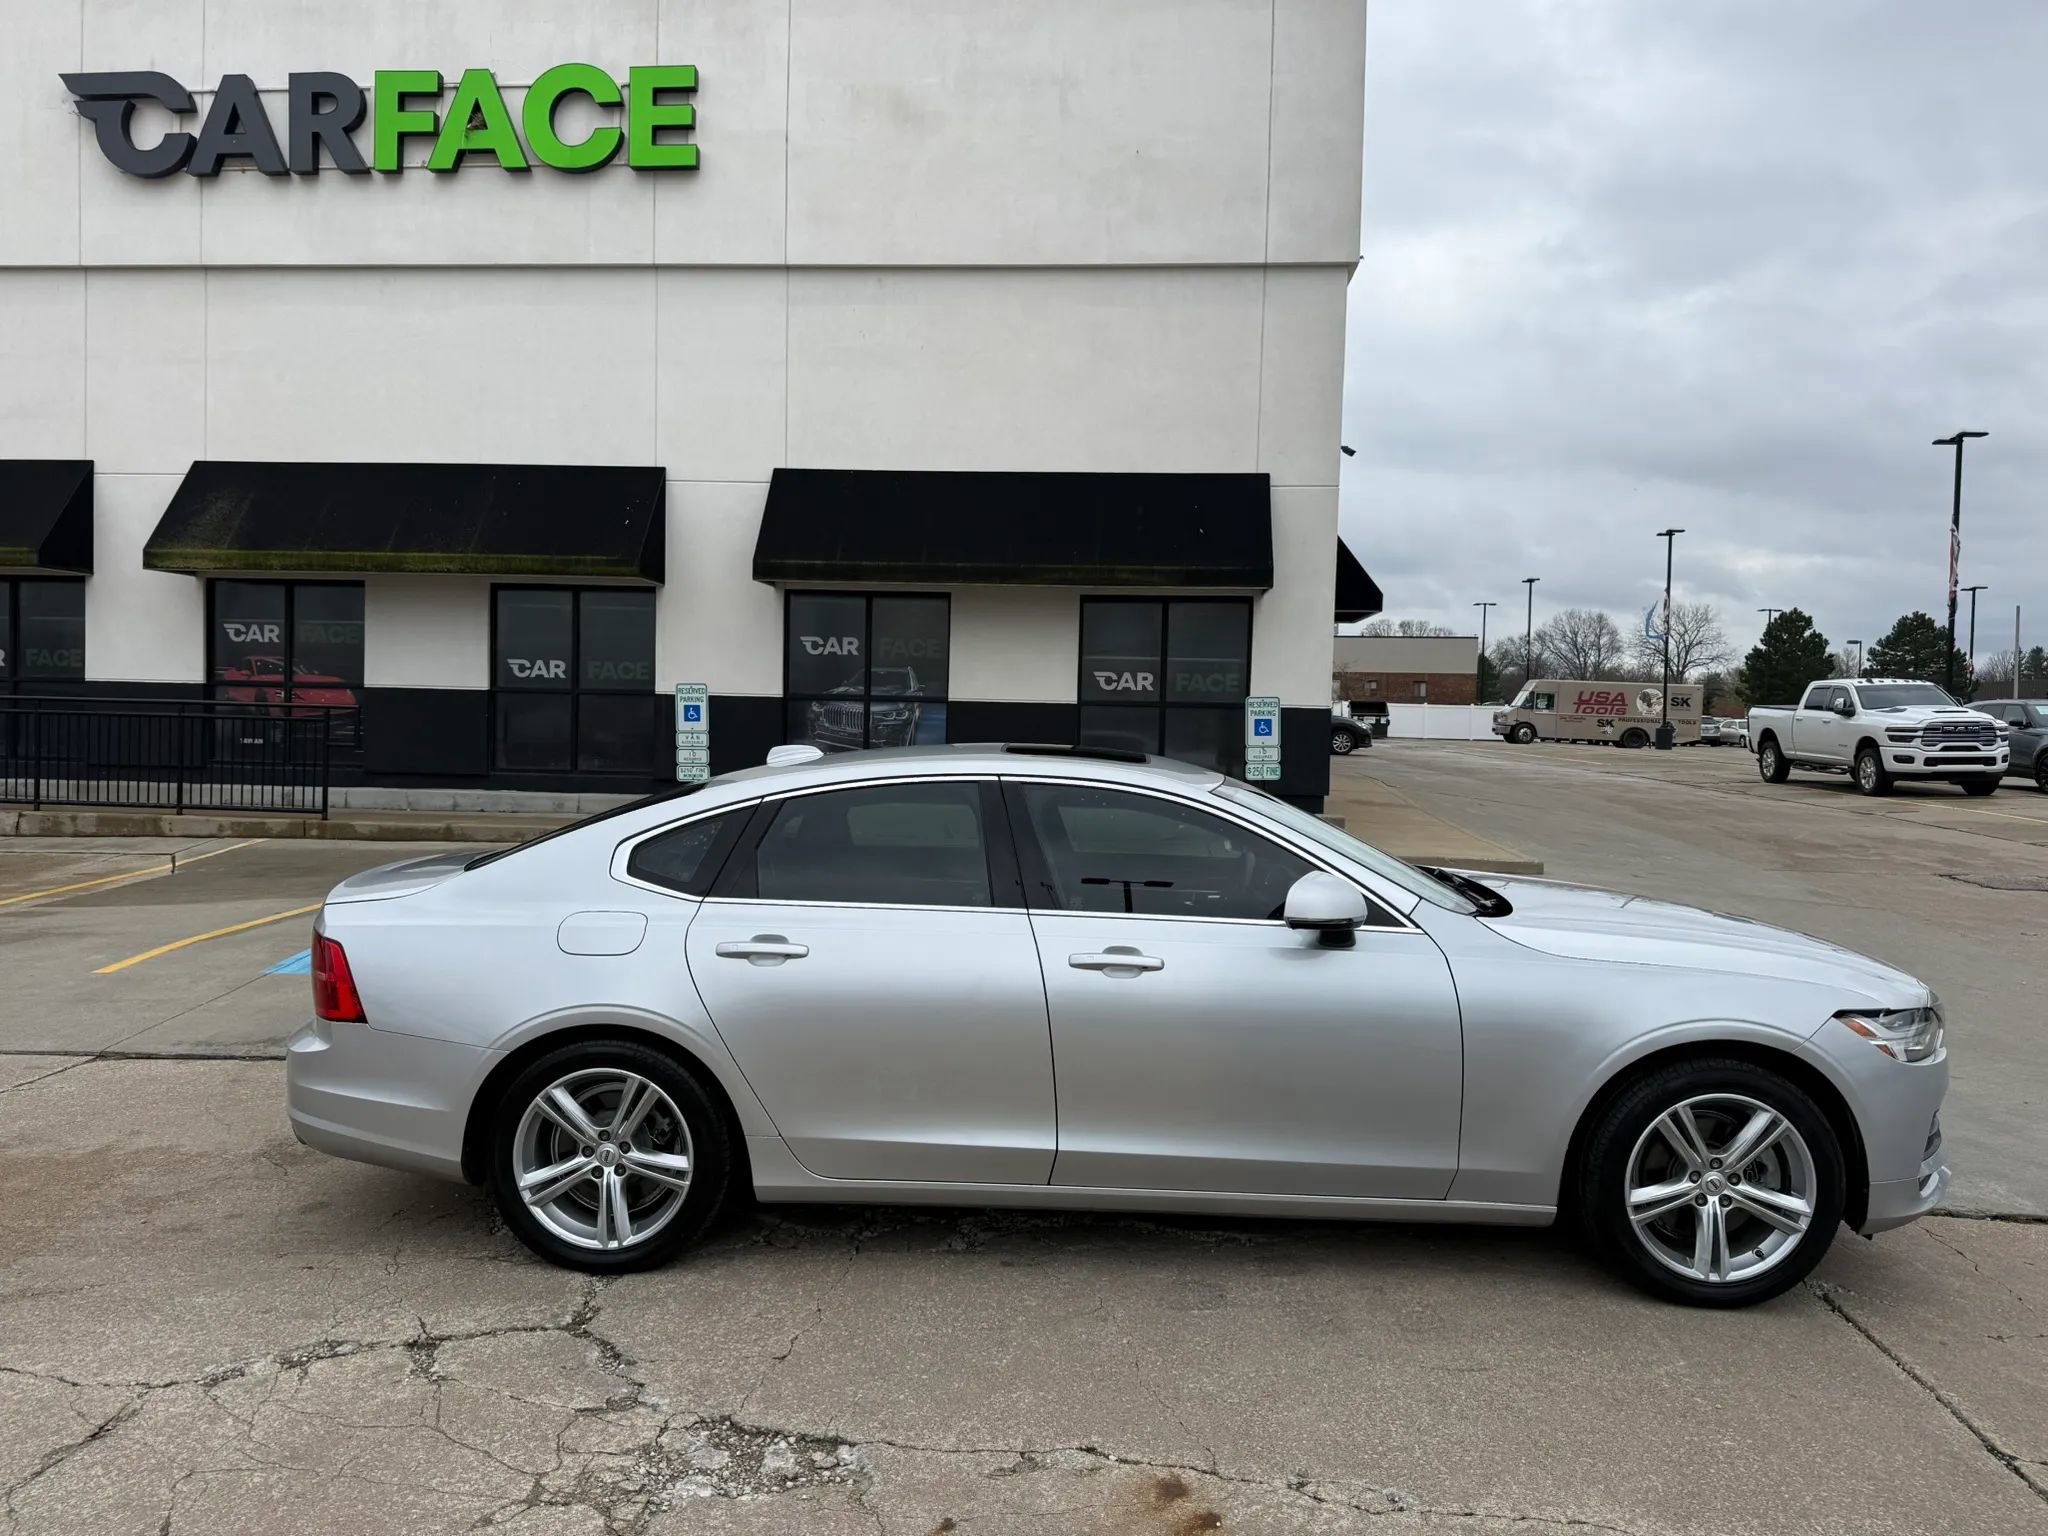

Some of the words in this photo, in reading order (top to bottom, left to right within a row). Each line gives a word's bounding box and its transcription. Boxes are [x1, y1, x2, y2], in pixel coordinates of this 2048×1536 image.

[223, 623, 281, 643] CAR
[300, 624, 359, 644] FACE
[800, 636, 859, 655] CAR
[879, 638, 942, 657] FACE
[25, 648, 83, 668] FACE
[507, 658, 566, 678] CAR
[587, 661, 649, 679] FACE
[1093, 671, 1154, 691] CAR
[1176, 673, 1241, 692] FACE
[678, 687, 705, 695] RESERVED
[680, 695, 704, 703] PARKING
[1577, 690, 1626, 704] USA
[1250, 709, 1277, 717] PARKING
[1266, 766, 1280, 777] FINE
